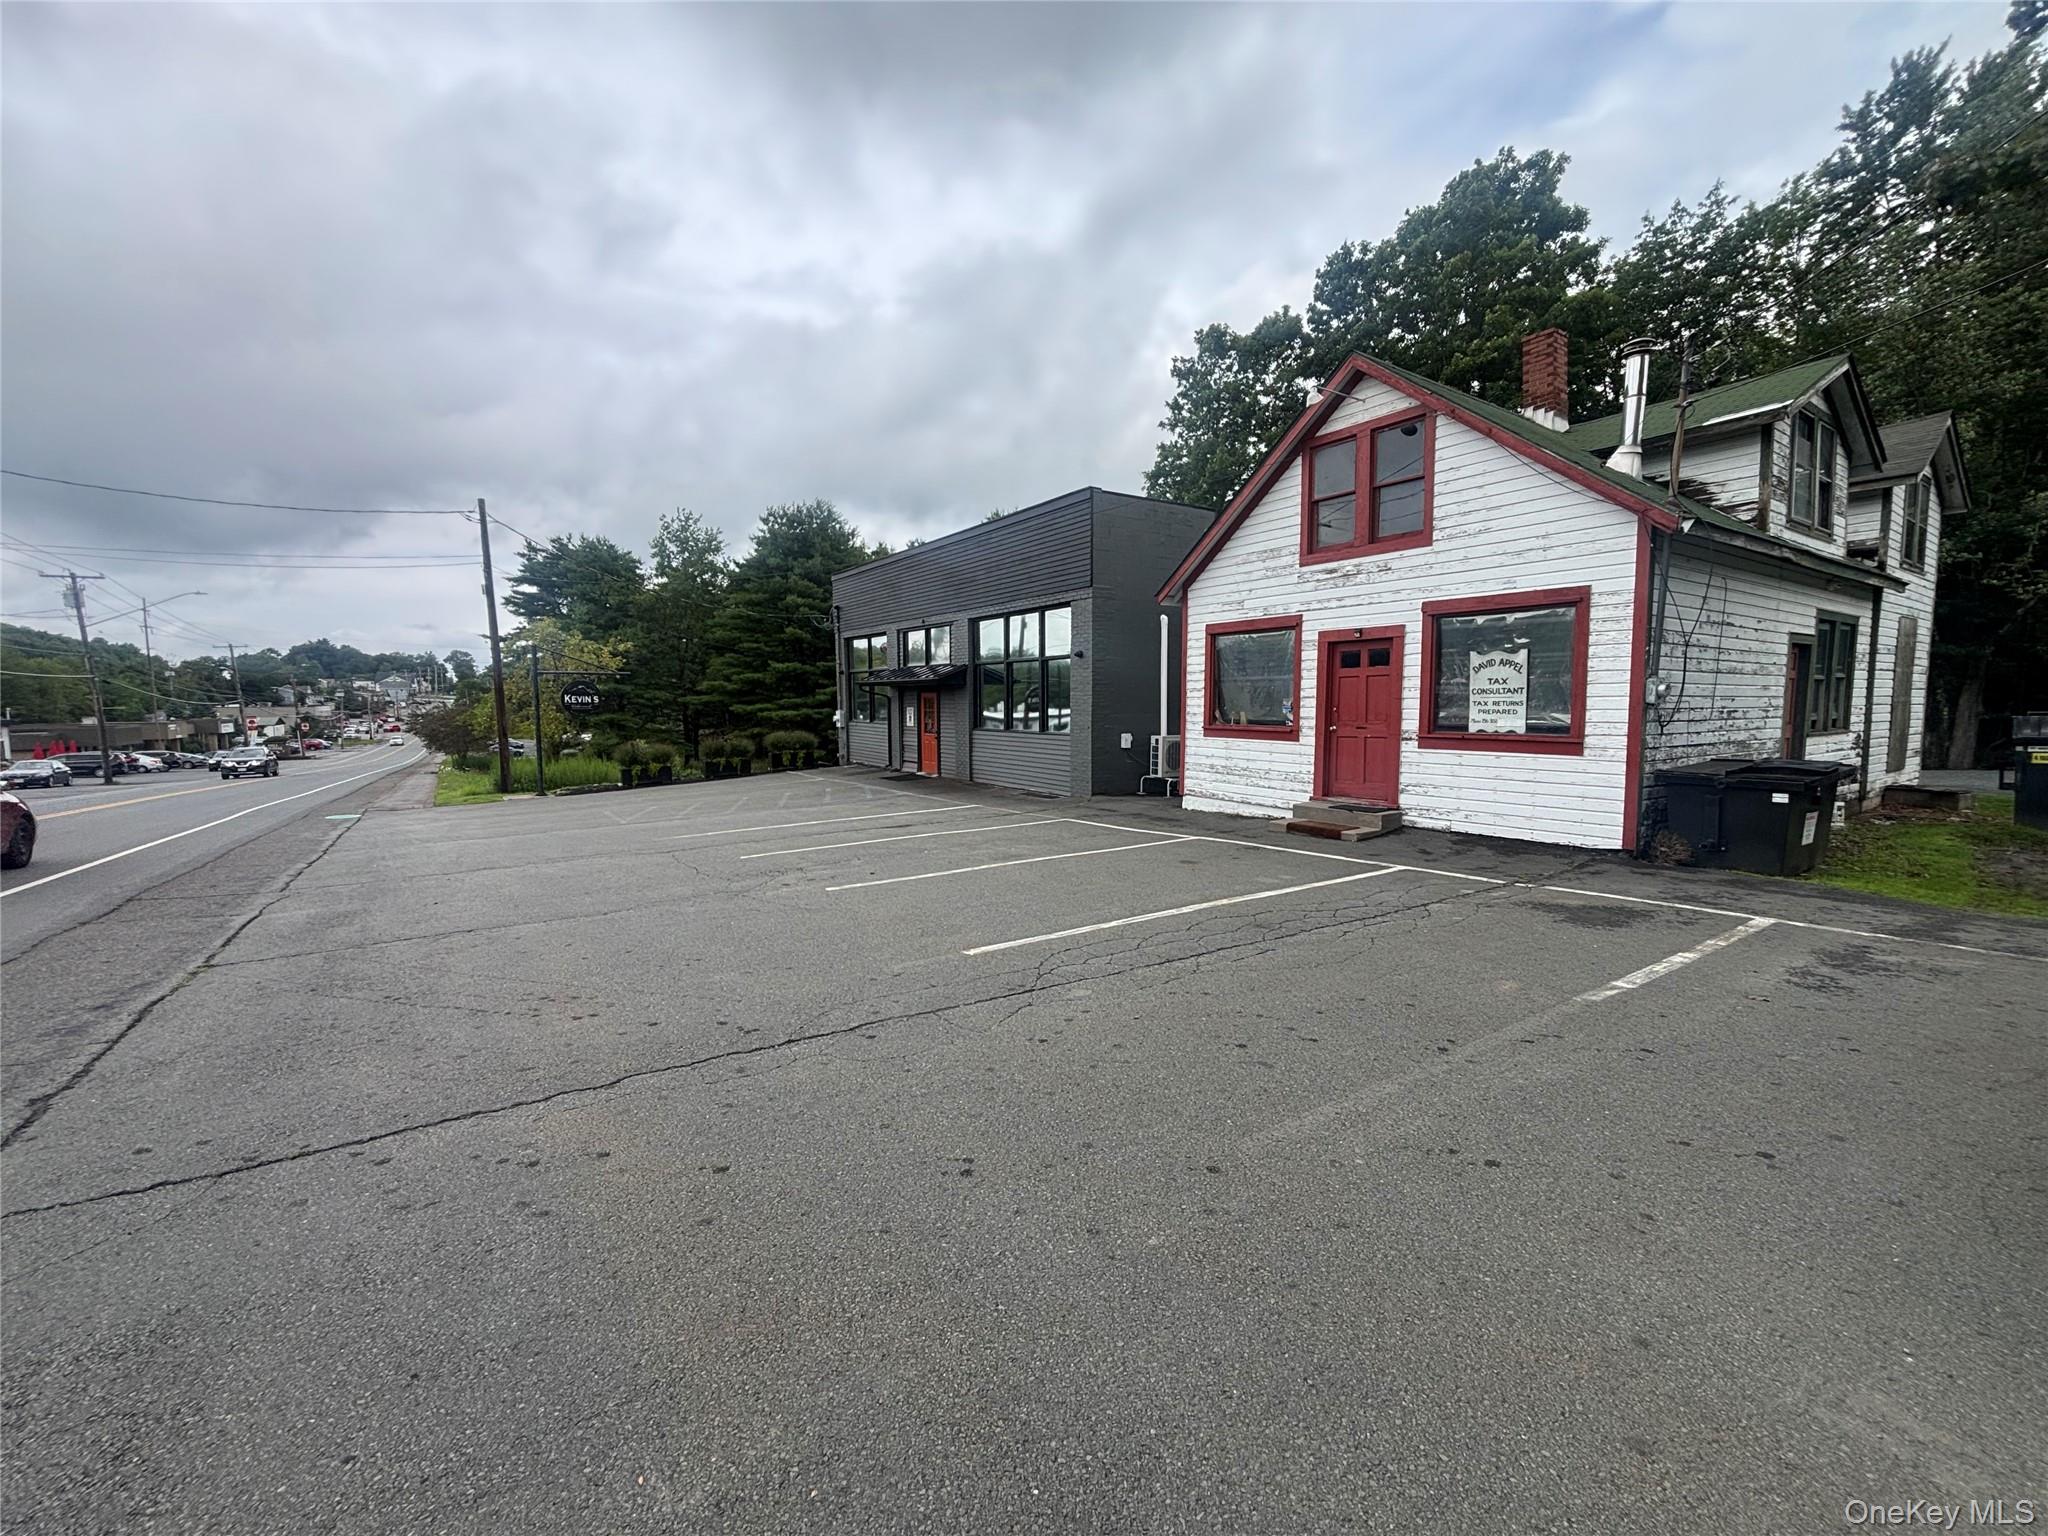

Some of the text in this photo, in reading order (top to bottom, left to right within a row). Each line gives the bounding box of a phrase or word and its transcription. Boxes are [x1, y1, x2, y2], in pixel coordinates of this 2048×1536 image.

[1472, 658, 1524, 674] DAVID APPEL
[1471, 687, 1525, 695] CONSULTANT
